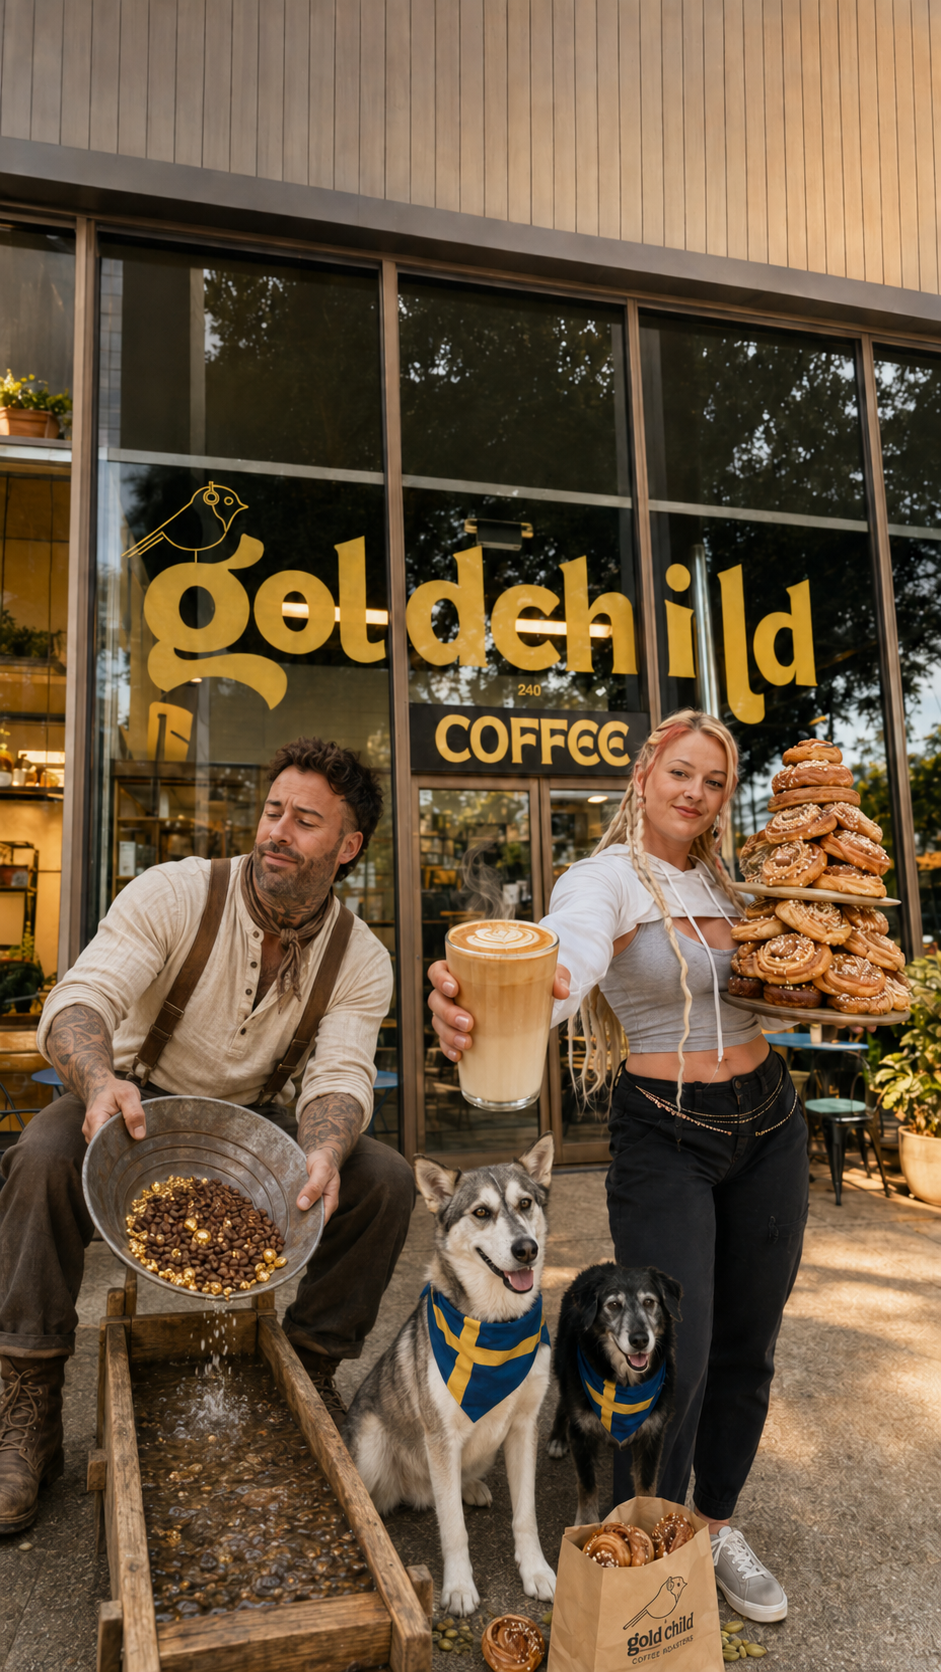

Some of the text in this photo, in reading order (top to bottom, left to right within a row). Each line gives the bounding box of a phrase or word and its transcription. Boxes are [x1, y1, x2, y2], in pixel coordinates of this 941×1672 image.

[517, 683, 542, 697] 240
[627, 1611, 694, 1656] gold child
[631, 1650, 661, 1665] COFFEE
